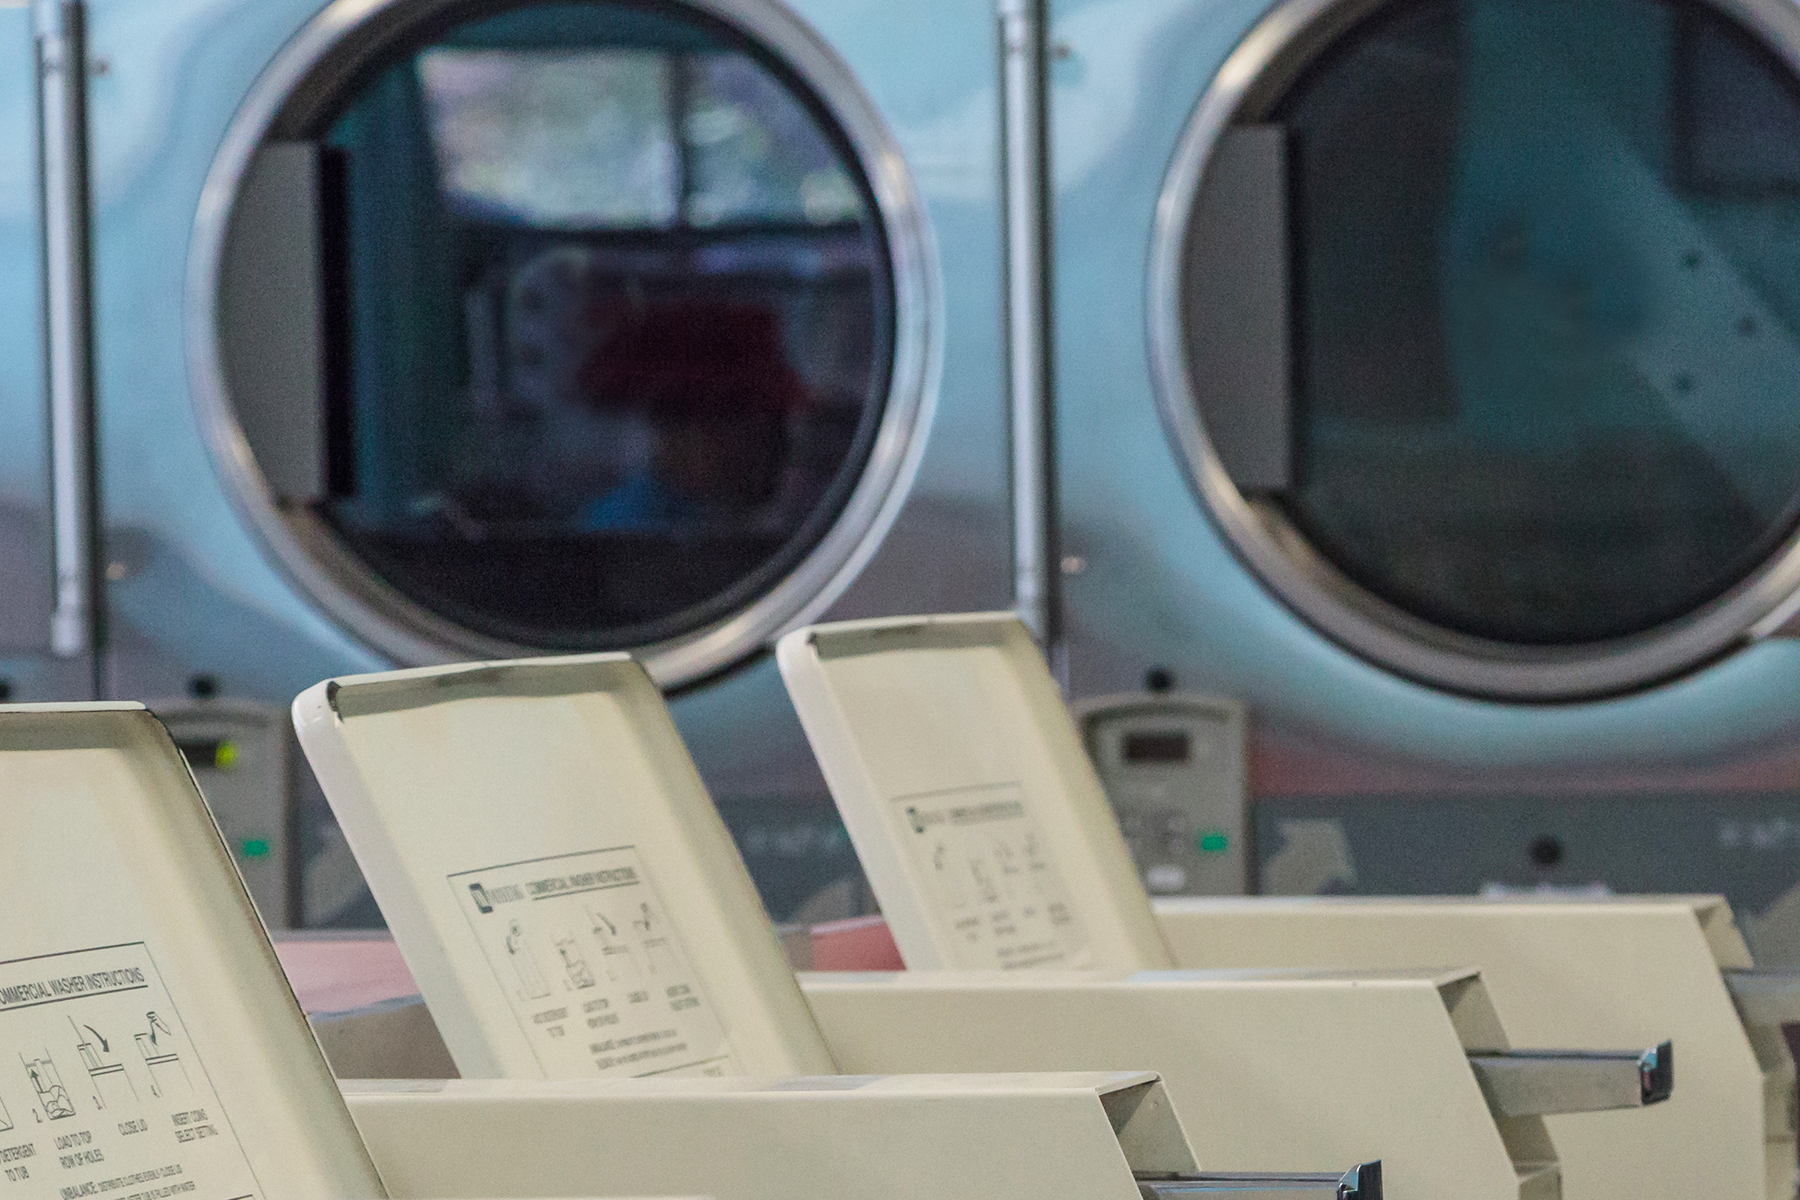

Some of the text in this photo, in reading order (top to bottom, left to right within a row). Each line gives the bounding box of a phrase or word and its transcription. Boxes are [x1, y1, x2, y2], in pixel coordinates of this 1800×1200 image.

[0, 967, 145, 1004] OMMERCIAL WASHER INSTRUCTIONS
[118, 1120, 139, 1136] CLOSE
[53, 1130, 92, 1150] LOAD TO TOP
[59, 1148, 104, 1169] ROW OF HOLES
[5, 1166, 30, 1184] TO TUB
